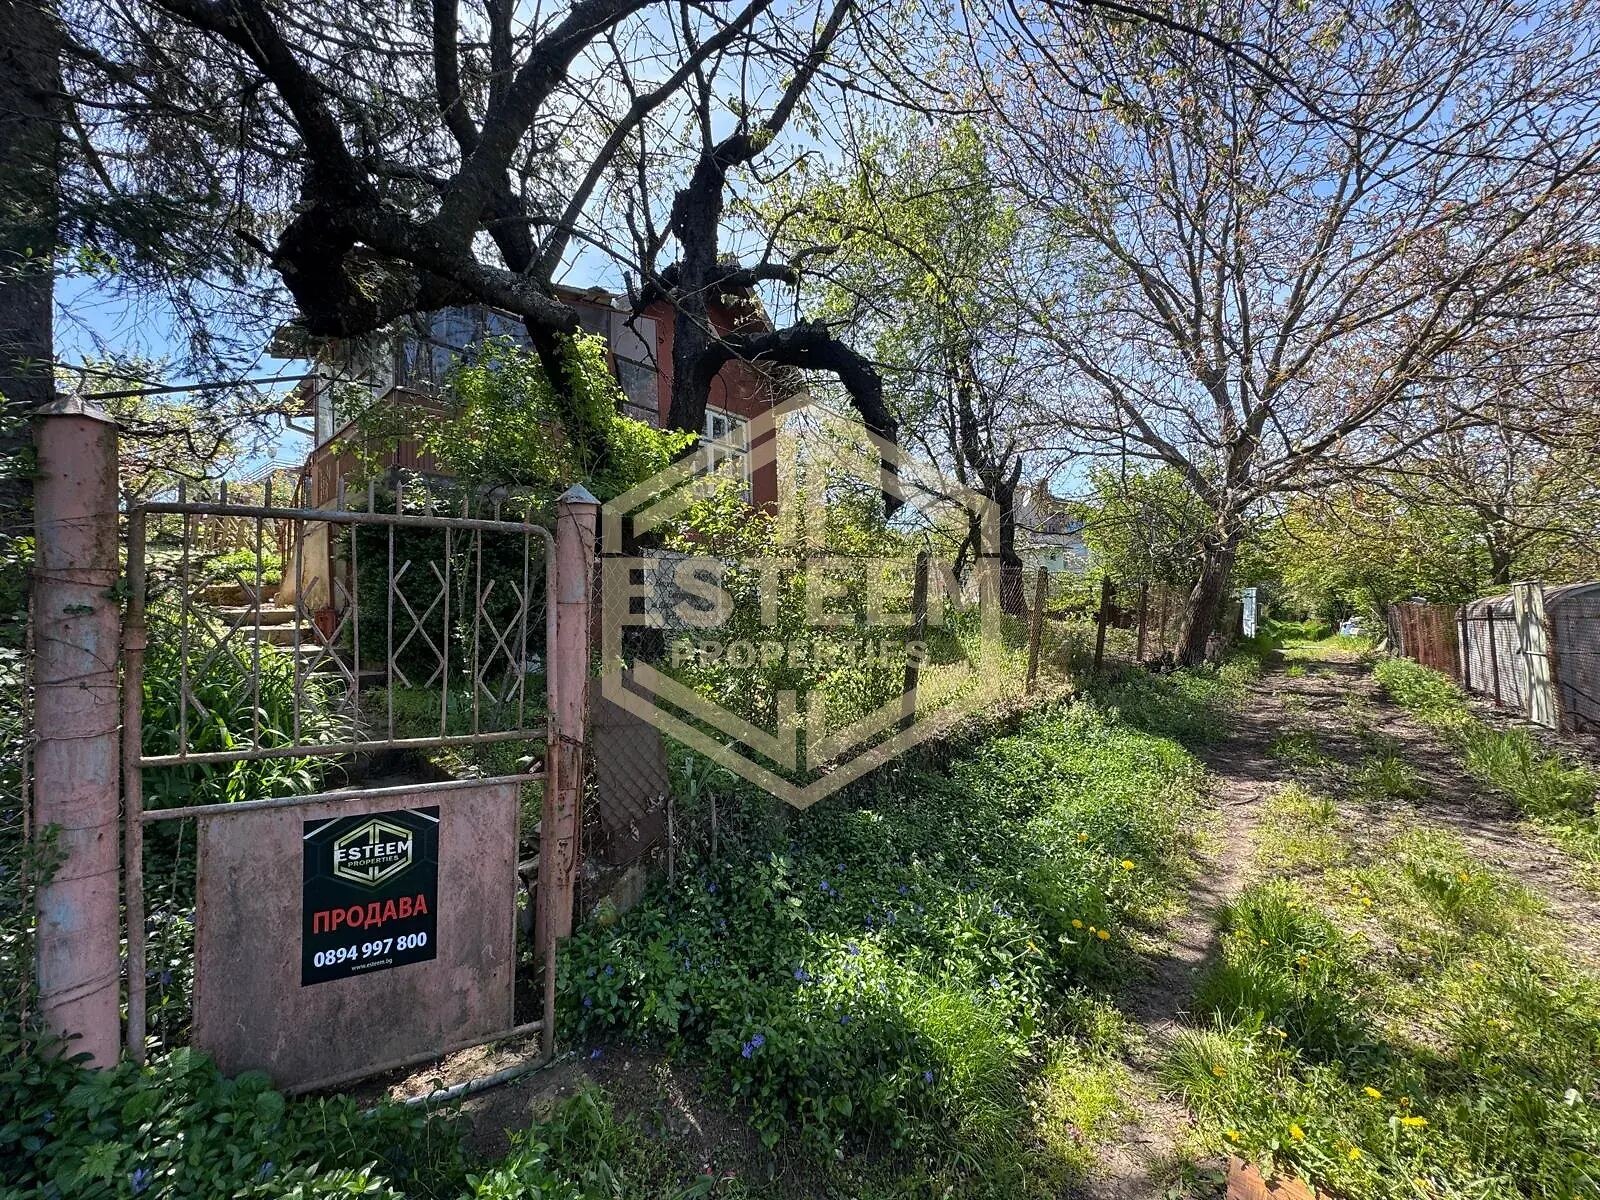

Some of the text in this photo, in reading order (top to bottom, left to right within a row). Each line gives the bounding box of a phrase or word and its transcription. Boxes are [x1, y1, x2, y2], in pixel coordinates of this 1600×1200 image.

[334, 840, 412, 862] ESTEEM
[347, 855, 399, 868] PROPERTIES
[313, 894, 428, 935] ПРОДАВА
[313, 931, 427, 968] 0894 997 800
[351, 958, 393, 971] www.esteem.bg
